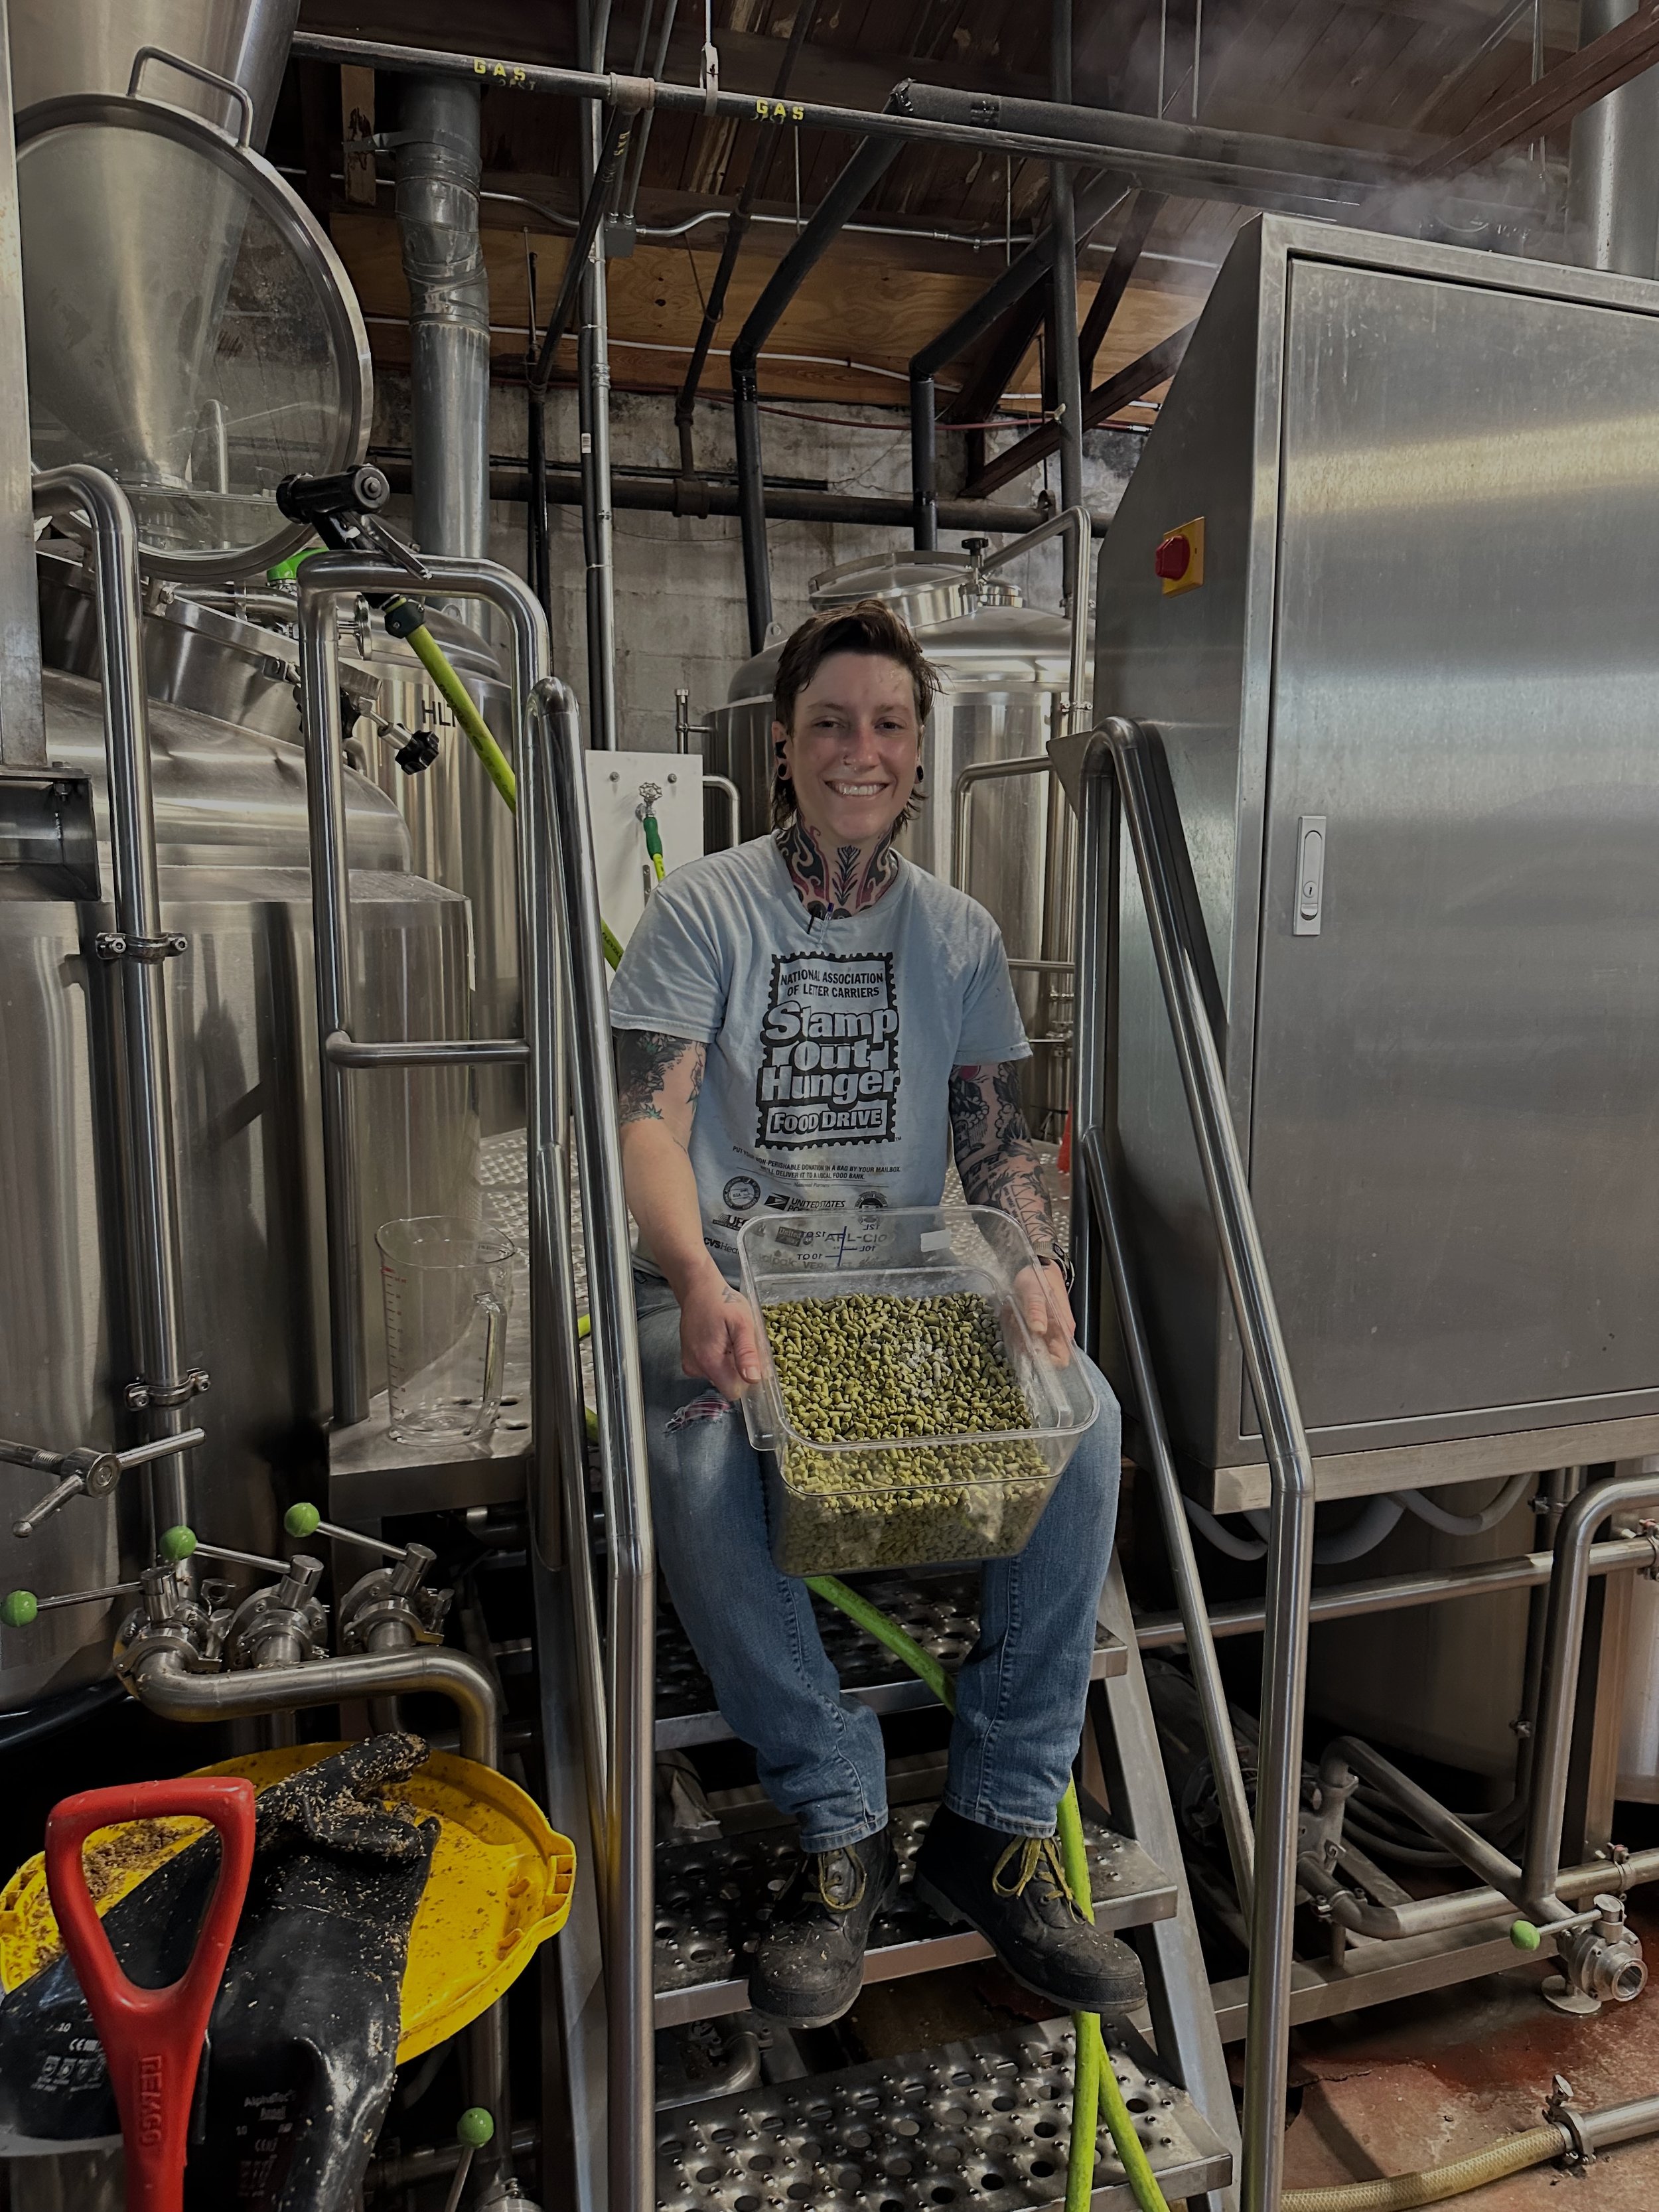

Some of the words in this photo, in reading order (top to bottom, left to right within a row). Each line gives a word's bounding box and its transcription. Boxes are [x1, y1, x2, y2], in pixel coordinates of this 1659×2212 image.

[473, 58, 526, 81] GAS
[756, 98, 804, 121] GAS
[780, 969, 820, 986] NATIONAL
[822, 972, 884, 985] ASSOCIATION
[787, 984, 800, 996] OF
[803, 984, 829, 997] LETTER
[831, 986, 880, 998] CARRIERS
[763, 1000, 899, 1045] Stamp
[794, 1039, 871, 1071] Out
[760, 1065, 901, 1105] Hunger
[770, 1112, 820, 1134] FOOD
[818, 1109, 882, 1132] DRIVE
[733, 1145, 743, 1154] PUT
[776, 1169, 799, 1178] DELIVER
[792, 1198, 820, 1208] UNITED
